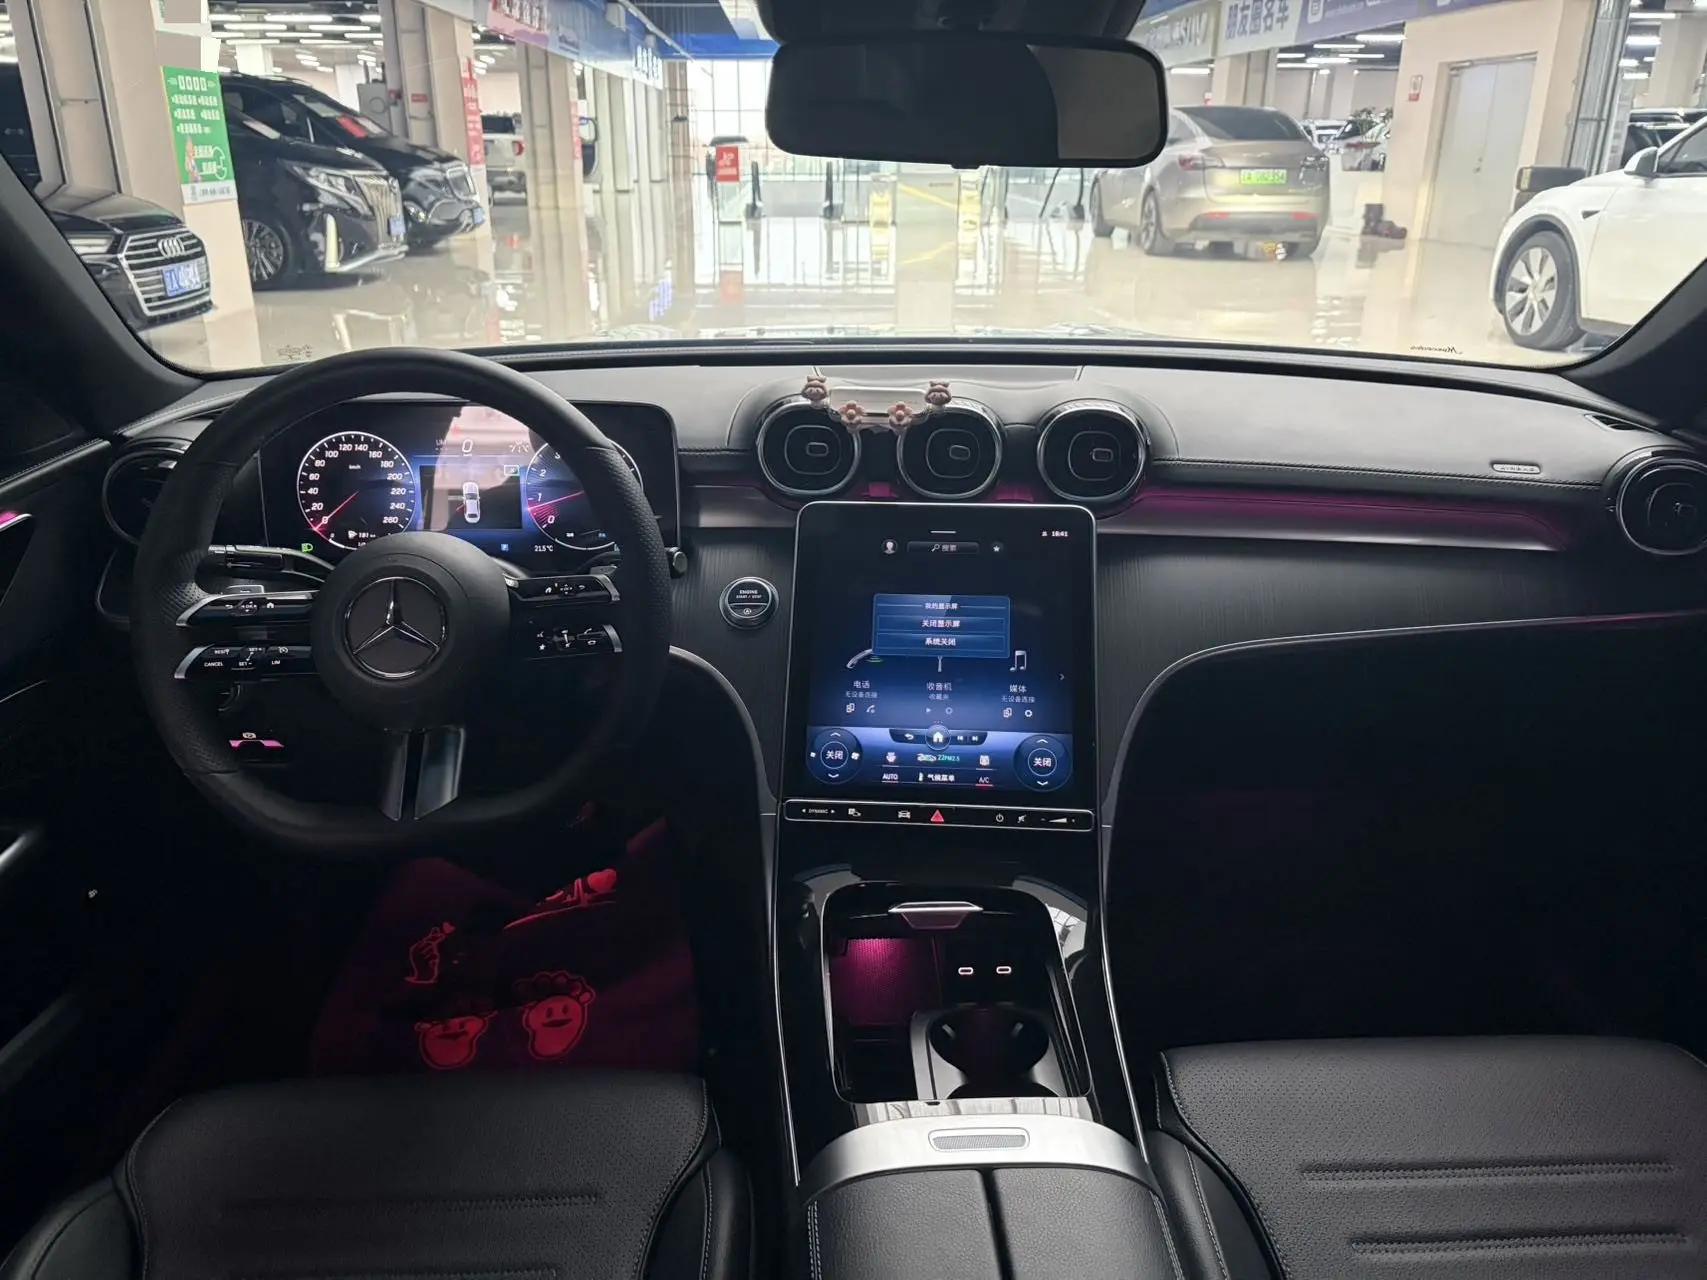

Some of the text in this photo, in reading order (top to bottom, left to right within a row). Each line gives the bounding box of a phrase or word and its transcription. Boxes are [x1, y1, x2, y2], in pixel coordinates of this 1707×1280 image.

[381, 460, 394, 468] 180
[540, 469, 547, 477] 2
[390, 502, 405, 510] 240
[548, 515, 555, 524] 0
[922, 619, 960, 628] 关闭显示屏
[925, 637, 956, 646] 系统关闭
[853, 680, 870, 689] 电话
[926, 682, 952, 691] 收音机
[1009, 684, 1027, 693] 媒体
[1001, 695, 1035, 703] 无设备连接
[825, 750, 843, 760] 关闭
[1033, 757, 1052, 767] 关闭
[882, 773, 899, 781] AUTO
